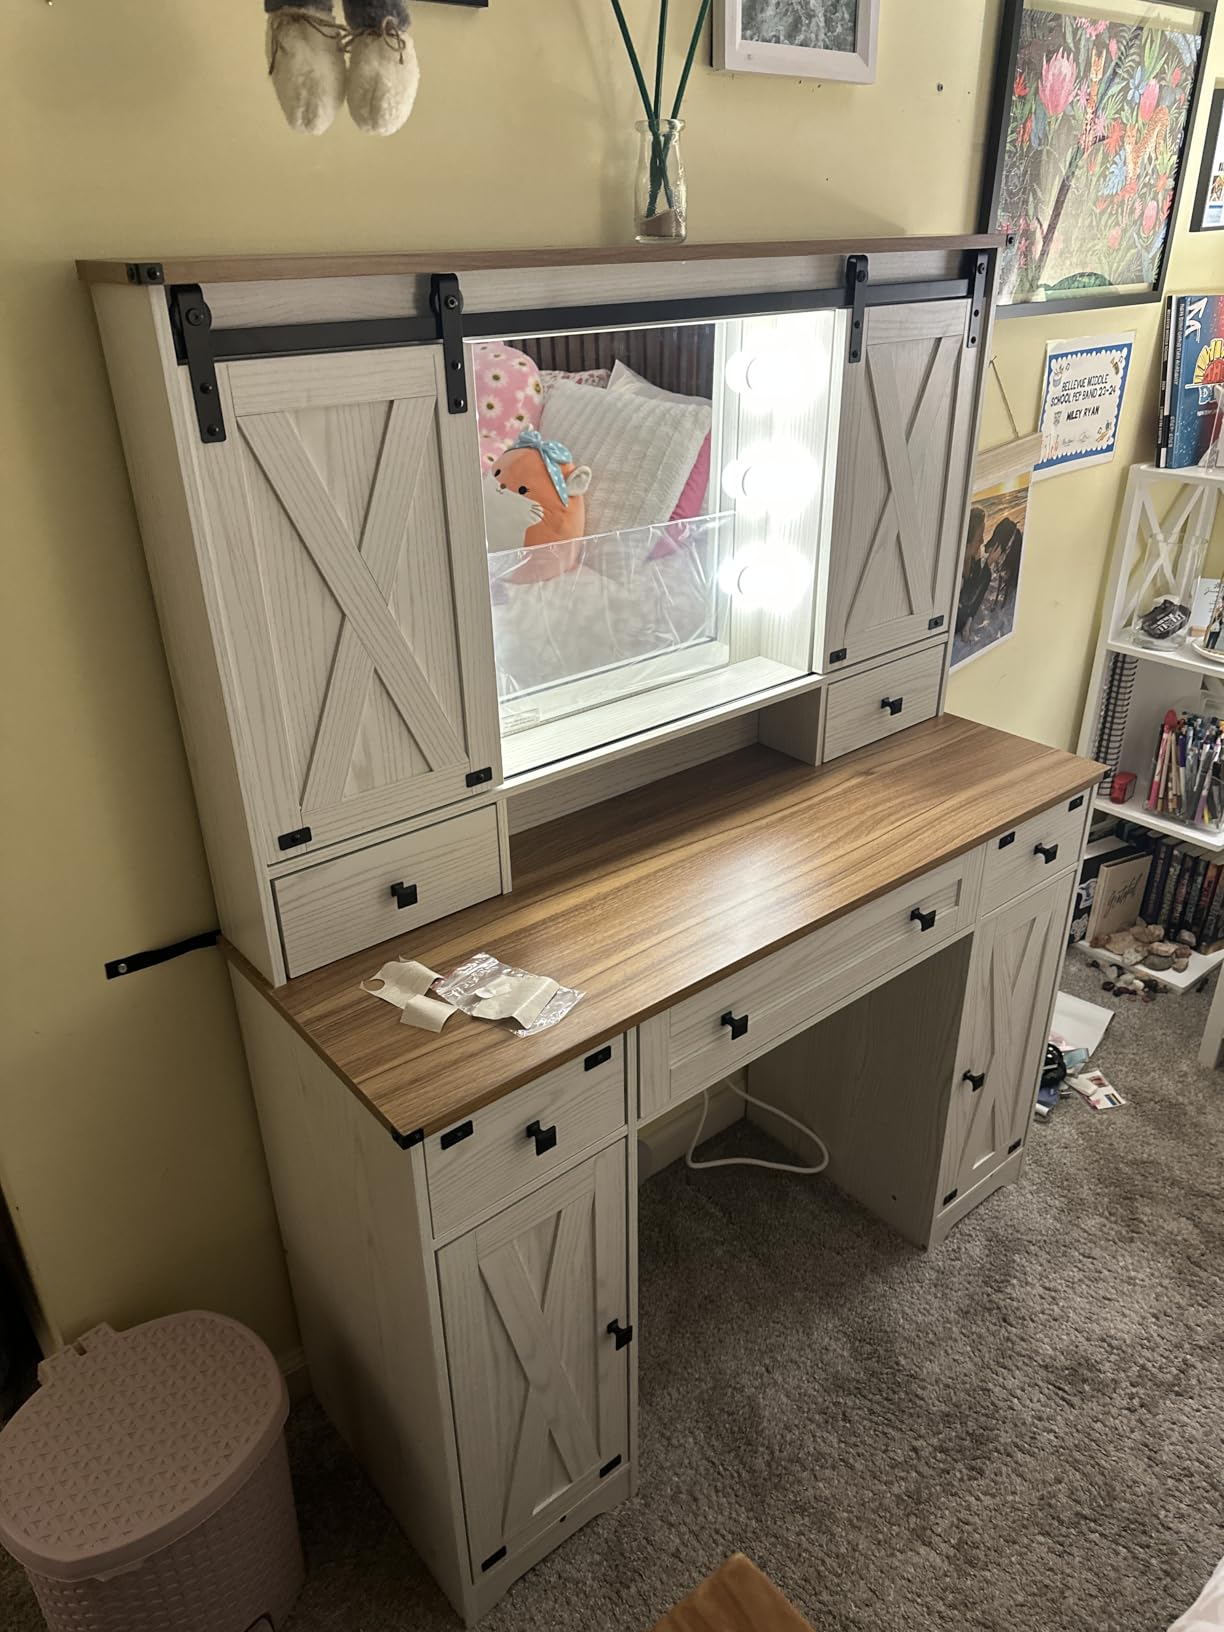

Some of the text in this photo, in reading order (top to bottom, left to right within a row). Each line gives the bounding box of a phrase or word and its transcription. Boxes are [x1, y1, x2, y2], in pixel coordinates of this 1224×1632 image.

[1062, 374, 1109, 392] BELLEVUE MIDDLE
[1050, 384, 1116, 407] SCHOOL PEP BAND 23-24
[1083, 406, 1100, 418] RYAN
